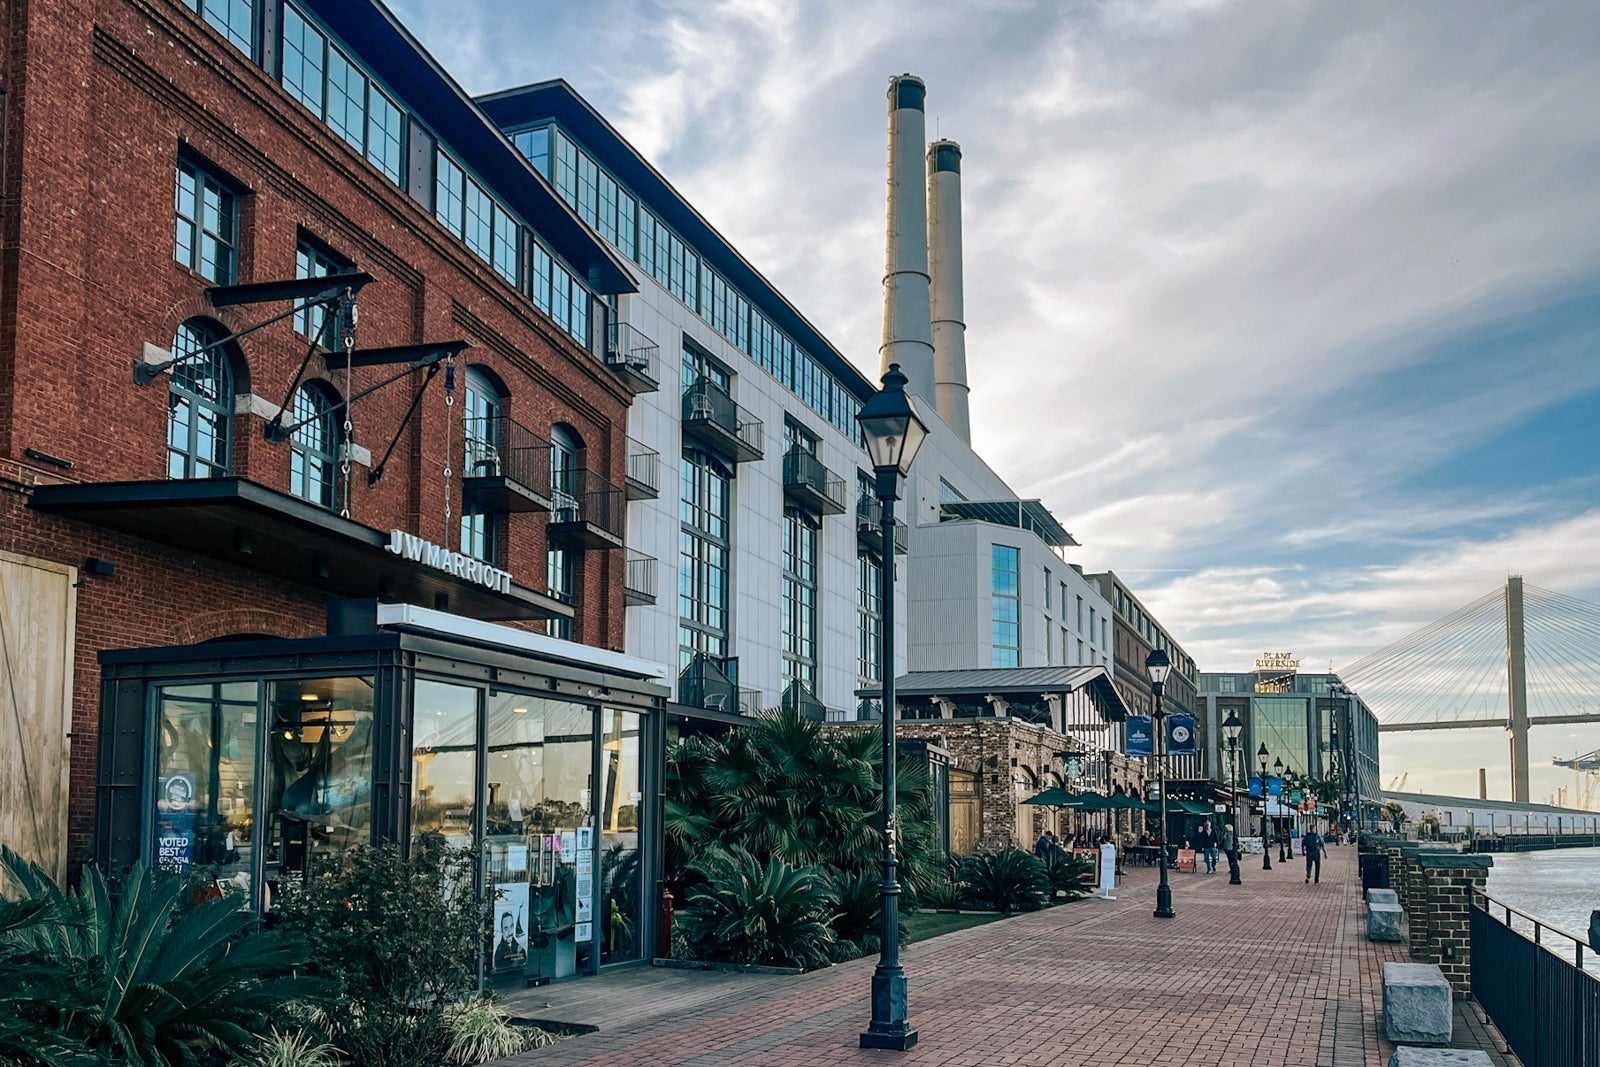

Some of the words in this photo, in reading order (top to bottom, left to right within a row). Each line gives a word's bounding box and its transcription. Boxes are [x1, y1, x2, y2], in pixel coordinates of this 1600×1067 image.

[422, 541, 513, 594] MARRIOTT
[1263, 652, 1292, 660] PLANT
[1255, 660, 1300, 668] RIVERSIDE
[159, 837, 188, 847] VOTED
[159, 847, 180, 856] BEST
